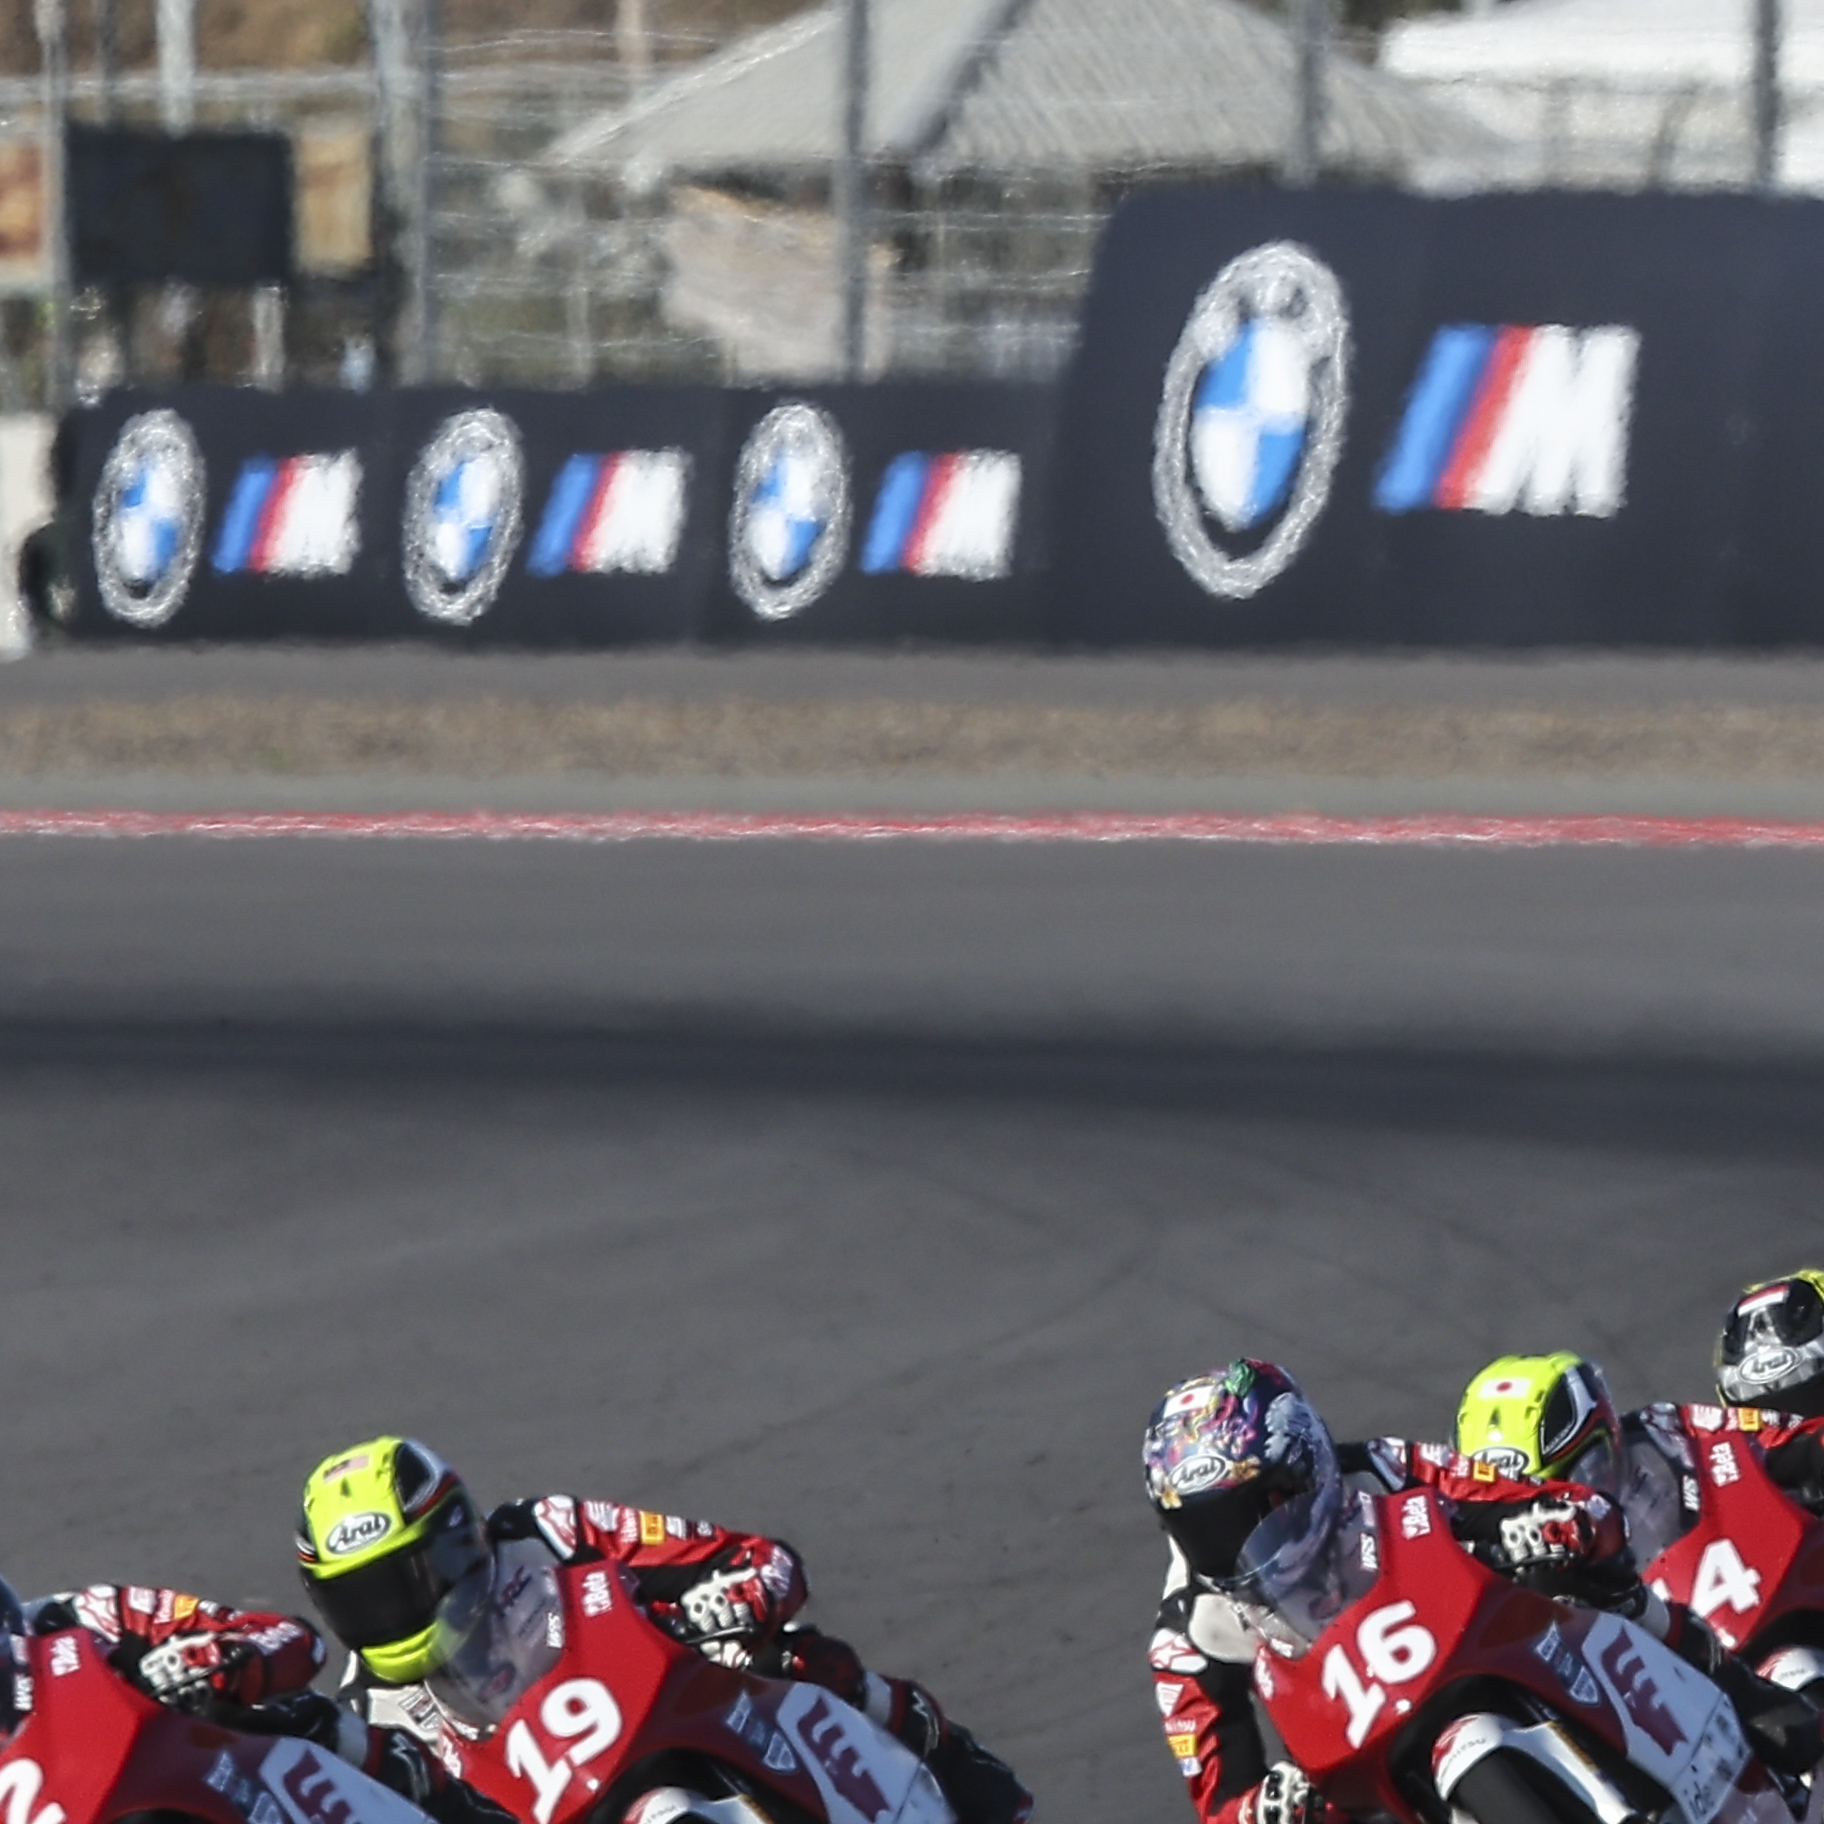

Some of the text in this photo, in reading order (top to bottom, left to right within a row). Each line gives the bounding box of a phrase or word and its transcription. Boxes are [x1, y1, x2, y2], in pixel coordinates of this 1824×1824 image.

[1174, 1457, 1218, 1488] Arai
[333, 1514, 382, 1550] Arai
[1322, 1600, 1438, 1749] 16
